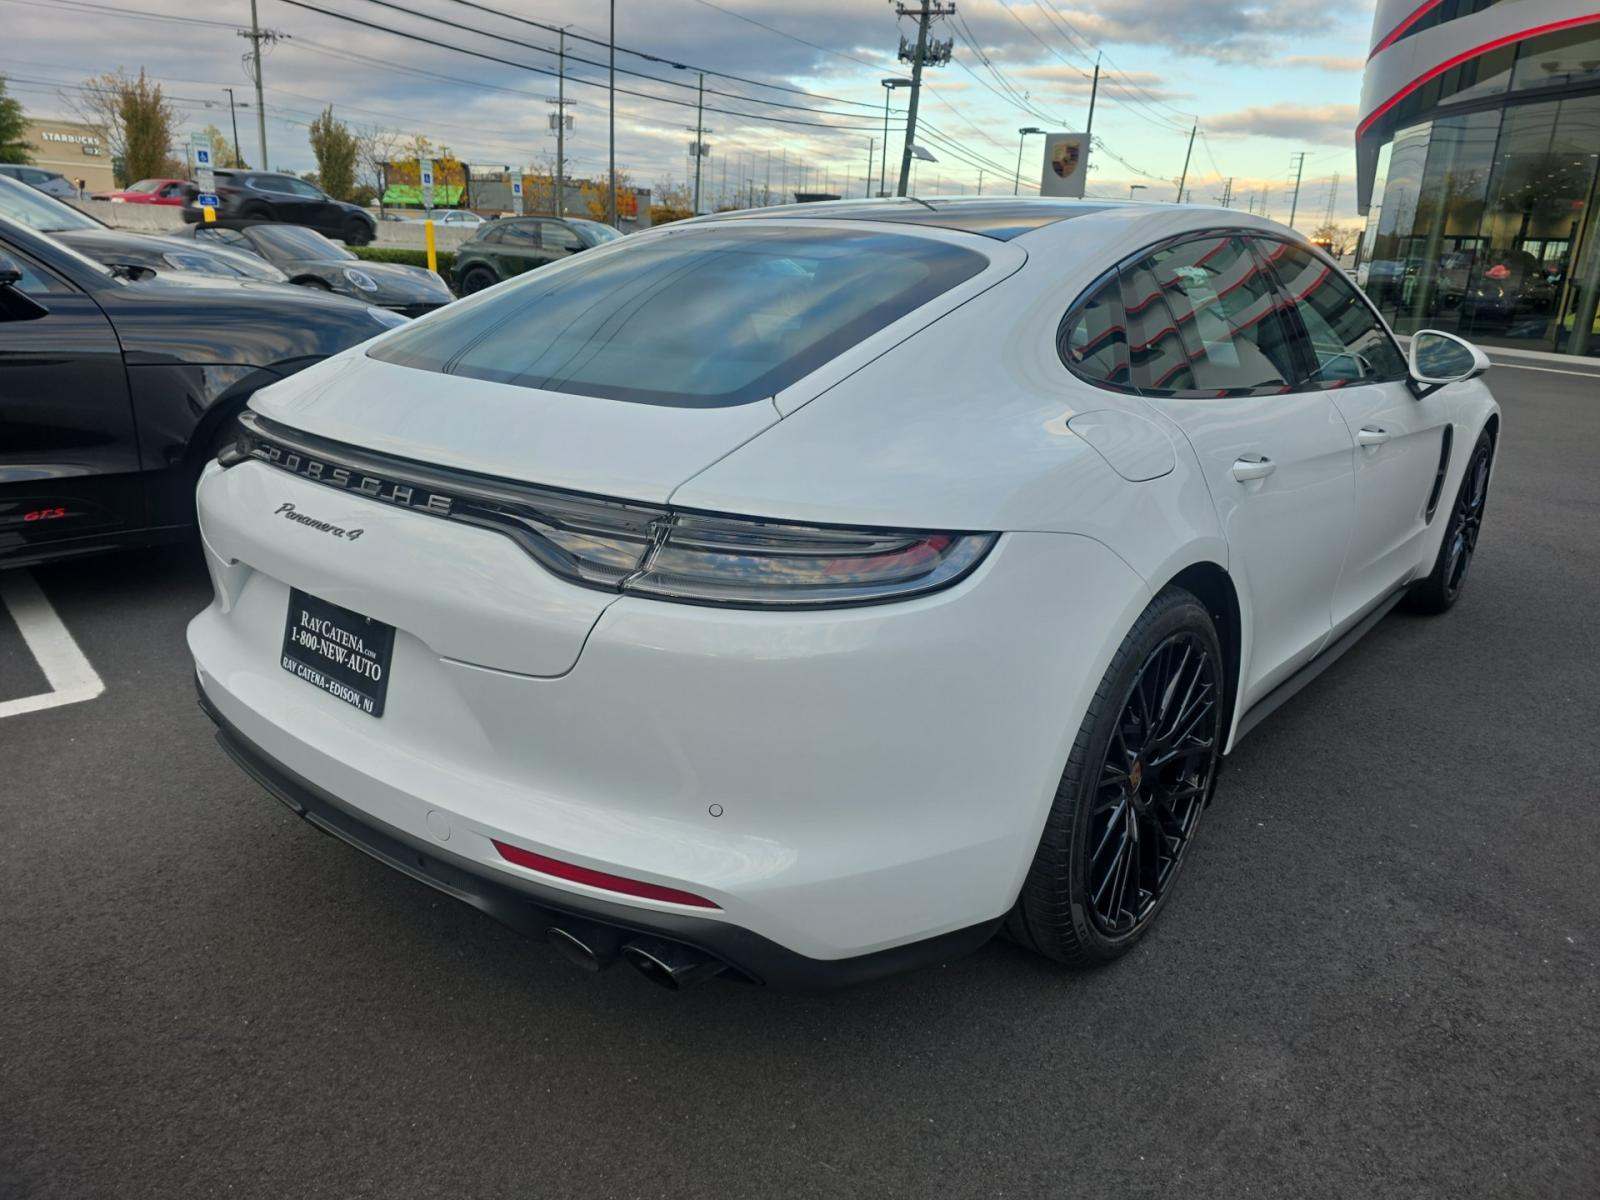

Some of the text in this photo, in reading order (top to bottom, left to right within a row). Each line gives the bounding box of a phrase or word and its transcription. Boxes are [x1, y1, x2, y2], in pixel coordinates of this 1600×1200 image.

[262, 445, 452, 516] PORSCHE
[23, 507, 65, 522] GTS
[274, 502, 364, 541] Panamera 4
[291, 626, 381, 681] 1-800-NEW-AUTO
[282, 656, 296, 673] RAY
[363, 698, 374, 713] NJ
